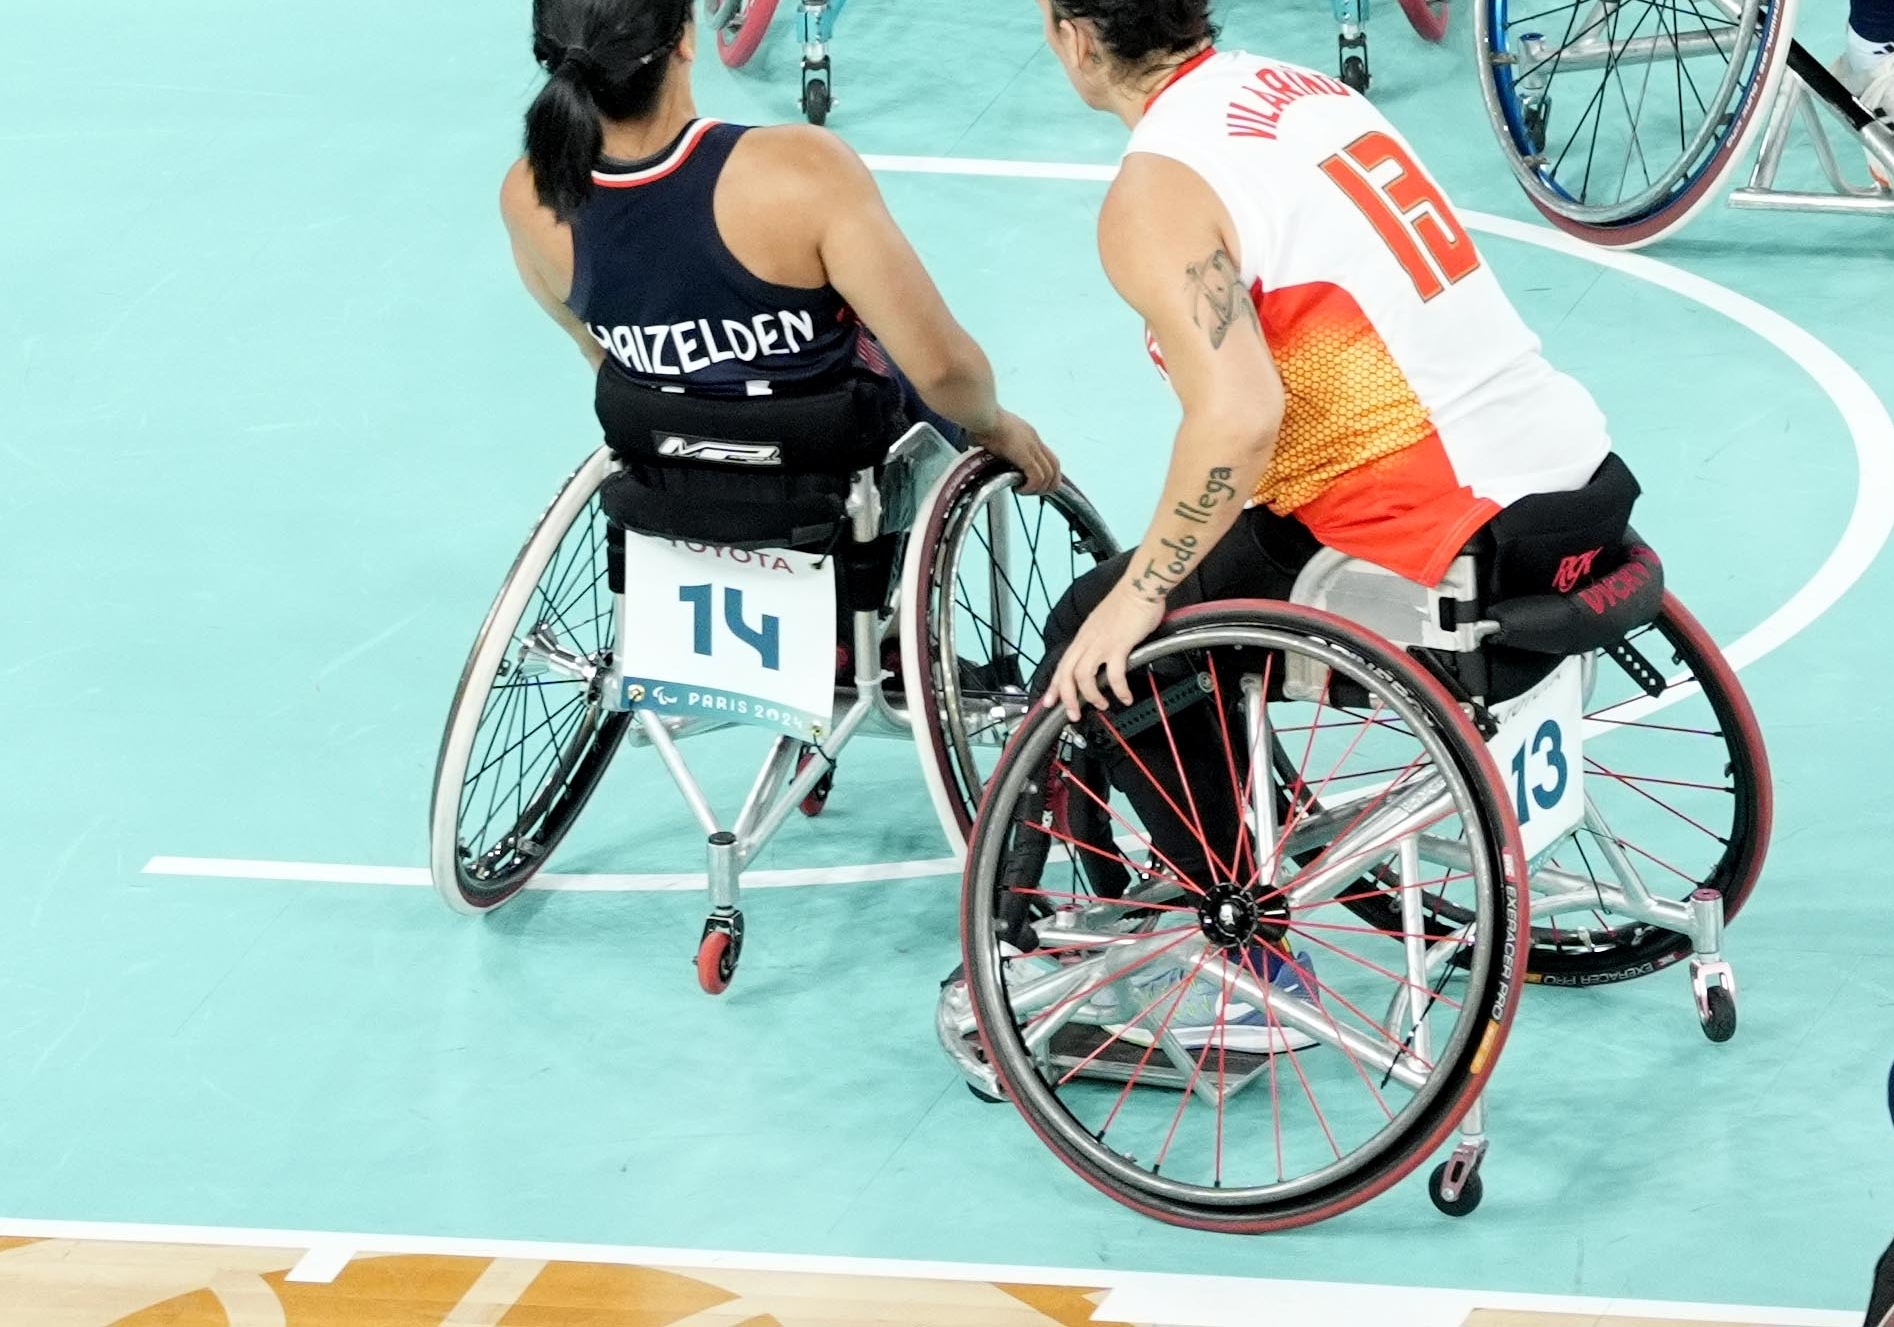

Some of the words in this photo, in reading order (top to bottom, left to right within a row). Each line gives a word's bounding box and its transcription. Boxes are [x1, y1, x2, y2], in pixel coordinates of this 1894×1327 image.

[1318, 131, 1480, 303] 13
[1144, 533, 1195, 582] Todo
[1175, 465, 1235, 523] llega
[679, 583, 779, 671] 14
[688, 692, 747, 713] PARIS
[754, 704, 803, 729] 2024
[1512, 719, 1567, 826] 13
